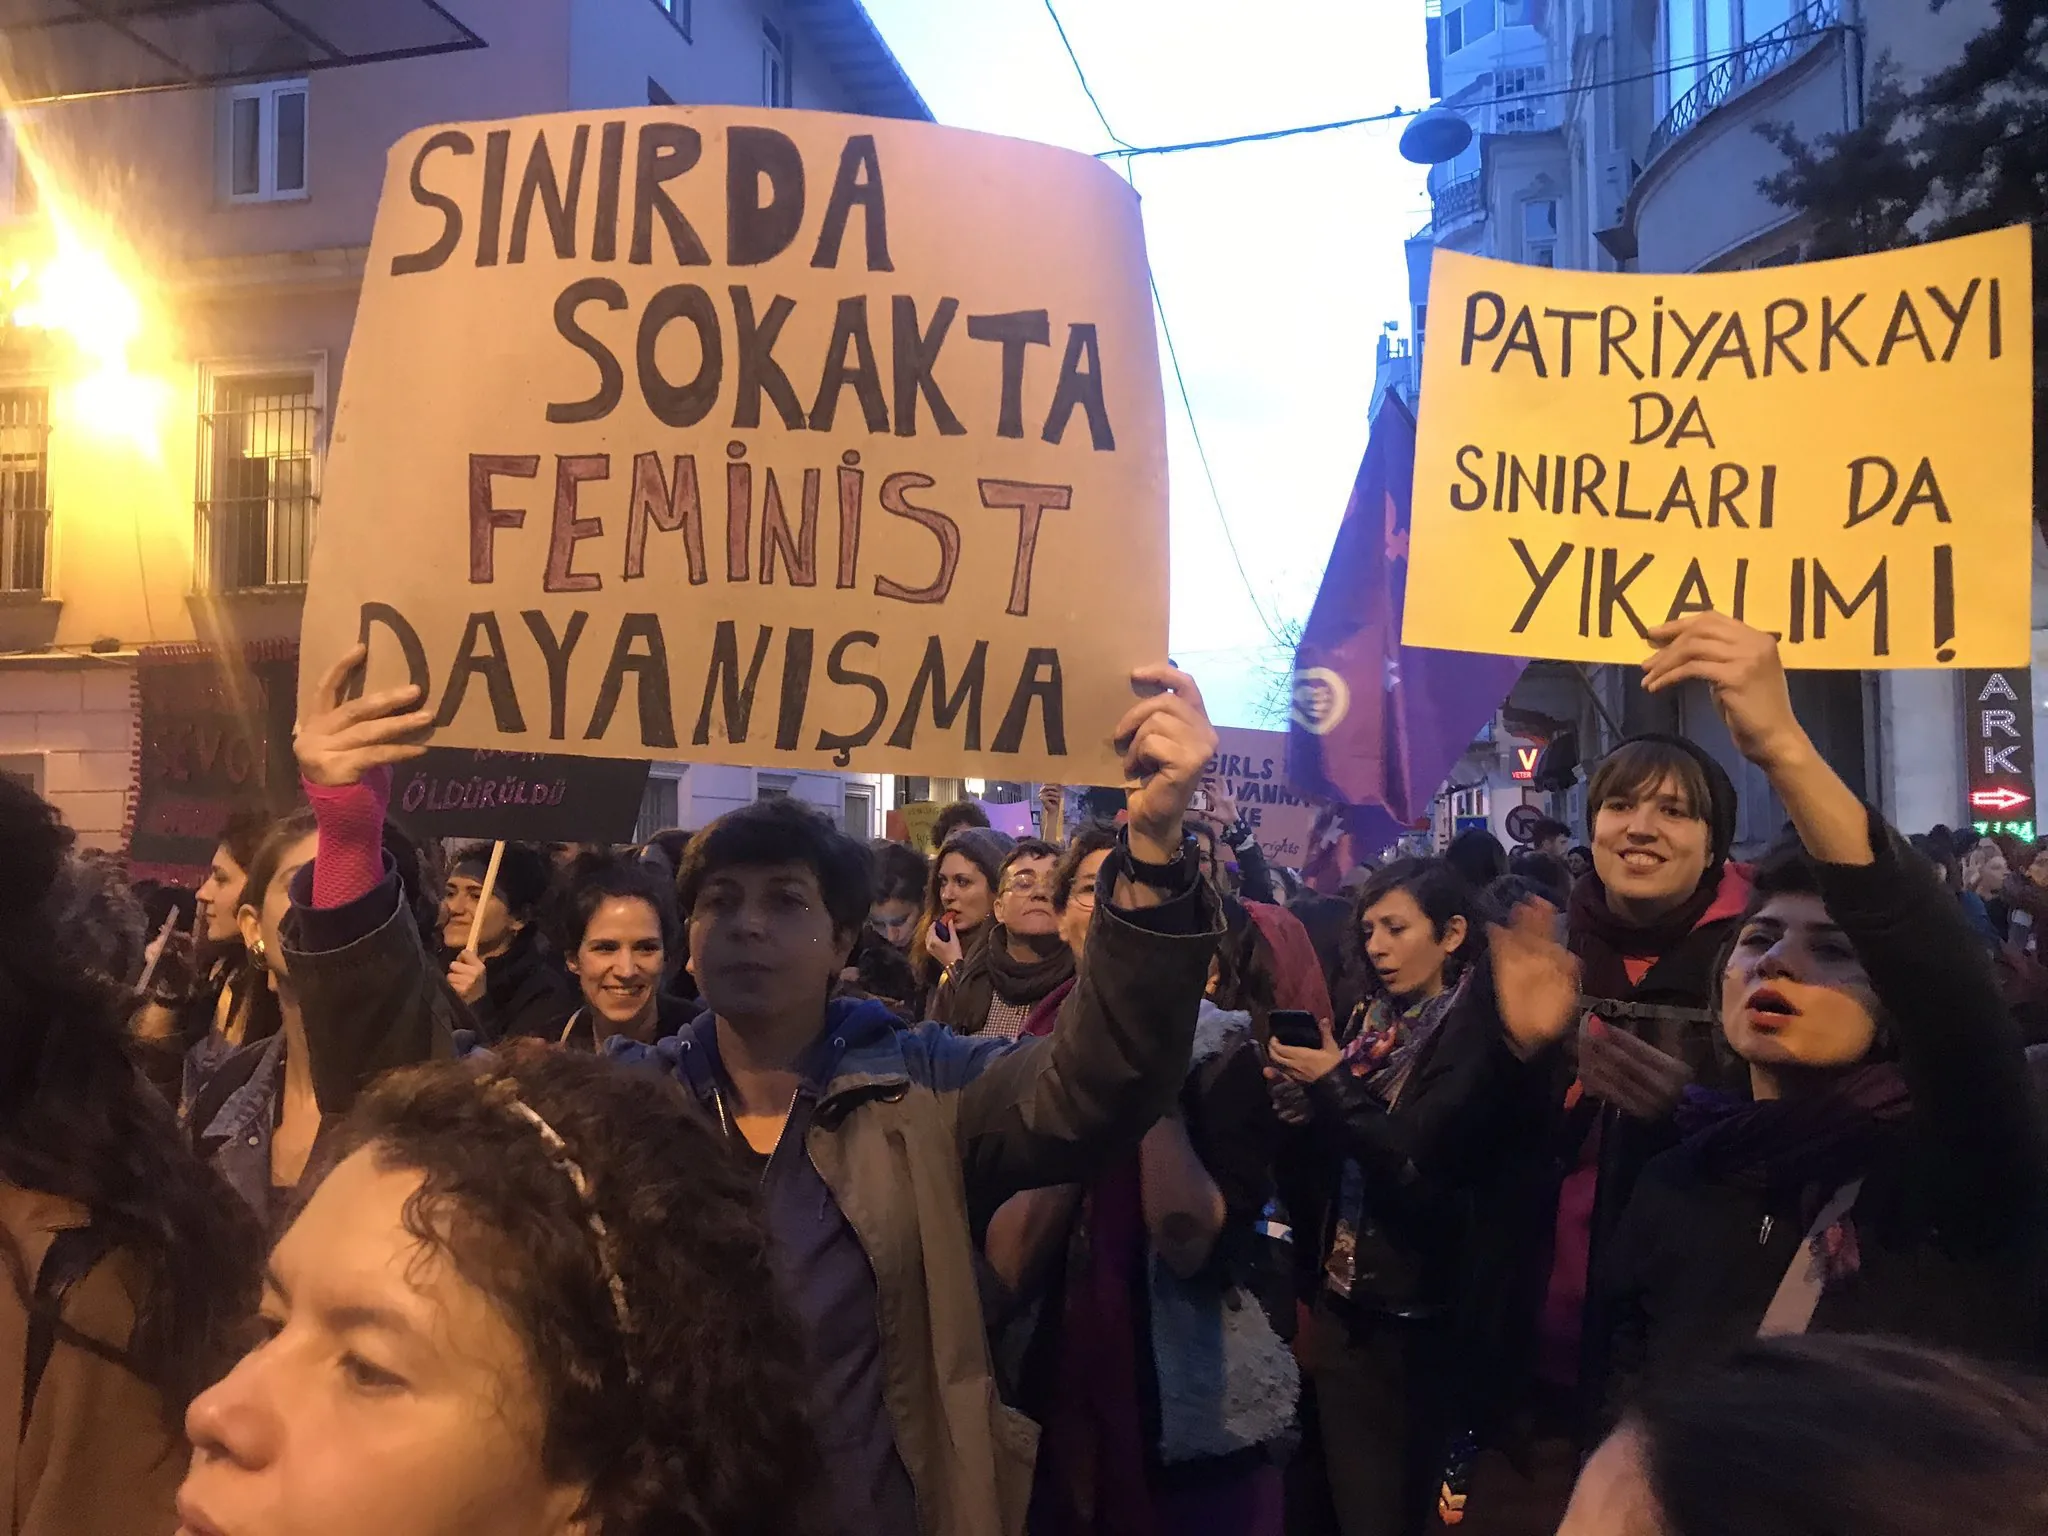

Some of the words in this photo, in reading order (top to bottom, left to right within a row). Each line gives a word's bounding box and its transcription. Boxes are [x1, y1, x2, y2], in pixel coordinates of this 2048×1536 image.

[391, 121, 895, 277] SINIRDA
[546, 277, 1116, 451] SOKAKTA
[1460, 277, 2001, 380] PATRİYARKAYI
[1628, 391, 1716, 449] DA
[468, 440, 1073, 617] FEMİNİST
[1450, 444, 1777, 529] SINIRLARI
[1843, 456, 1953, 530] DA
[347, 601, 1068, 767] DAYANIŞMA
[401, 771, 567, 813] ÖLDÜRÜLDÜ
